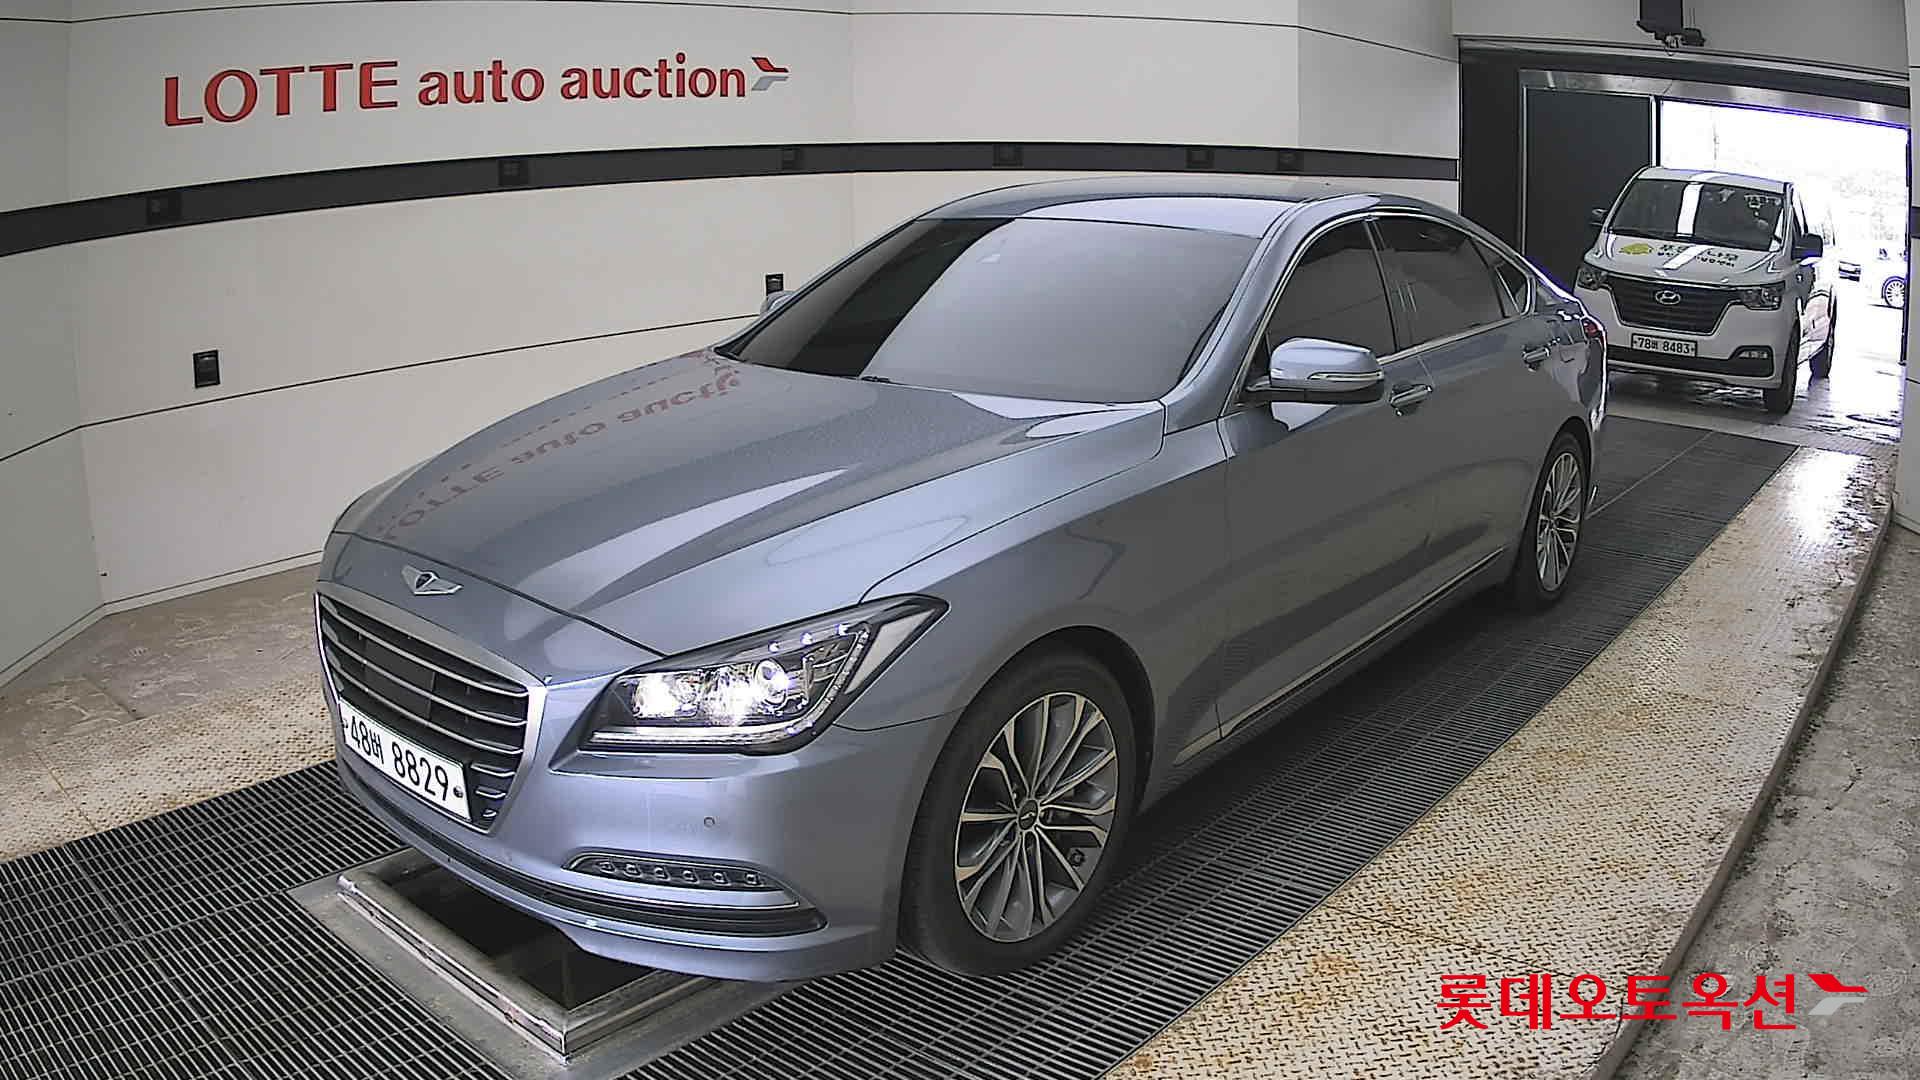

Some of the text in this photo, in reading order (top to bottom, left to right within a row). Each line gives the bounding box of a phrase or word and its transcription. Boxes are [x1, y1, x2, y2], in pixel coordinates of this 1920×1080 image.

[164, 52, 747, 127] LOTTE auto auction
[1662, 340, 1690, 354] 8483
[350, 716, 449, 801] 48버 8829
